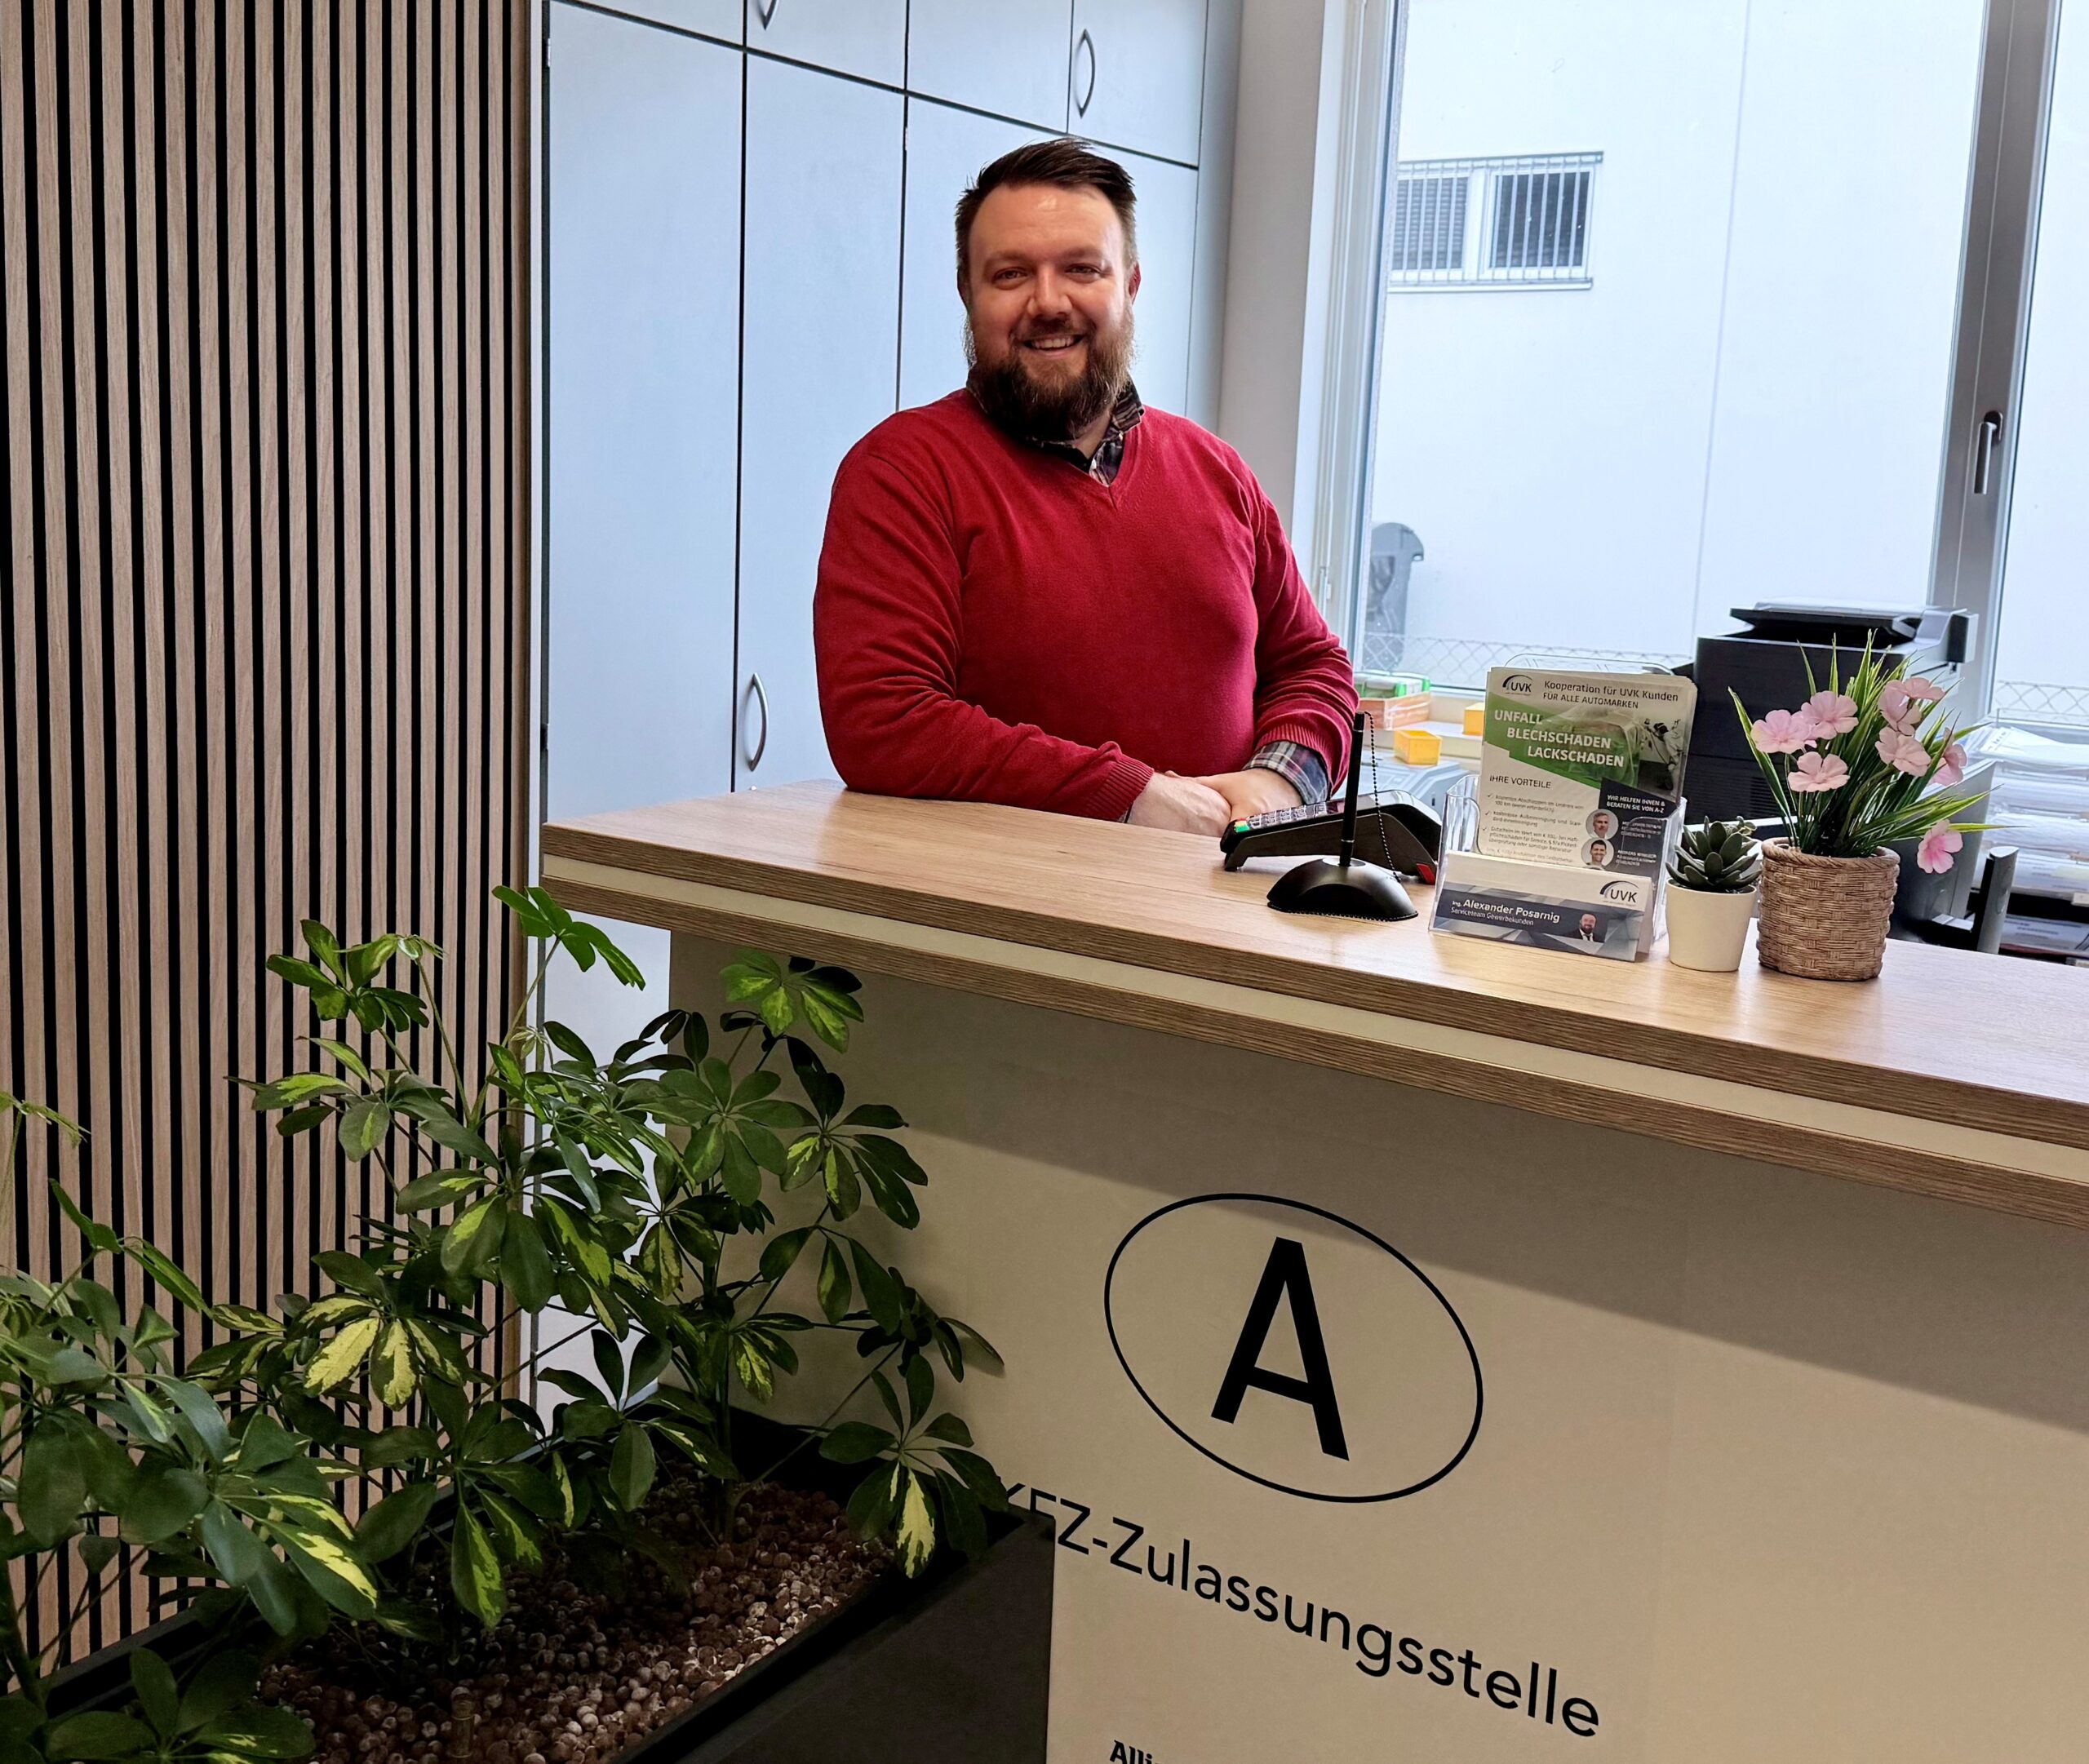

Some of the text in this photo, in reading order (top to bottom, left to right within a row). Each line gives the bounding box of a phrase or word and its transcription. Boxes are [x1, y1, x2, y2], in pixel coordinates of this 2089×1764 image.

[1510, 681, 1532, 693] UVK
[1544, 680, 1679, 702] Kooperation für UVK Kunden
[1543, 692, 1639, 709] FÜR ALLE AUTOMARKEN
[1494, 710, 1543, 725] UNFALL
[1506, 728, 1612, 749] BLECHSCHADEN
[1528, 746, 1624, 768] LACKSCHADEN
[1489, 775, 1551, 789] IHRE VORTEILE
[1611, 889, 1637, 902] UVK
[1451, 906, 1534, 926] Serviceteam Gewerbekunden
[1463, 899, 1514, 914] Alexander
[1515, 906, 1560, 924] Posarnig
[1211, 1237, 1350, 1461] A
[1006, 1483, 1599, 1737] FZ-Zulassungsstelle
[1110, 1740, 1160, 1764] Alli
